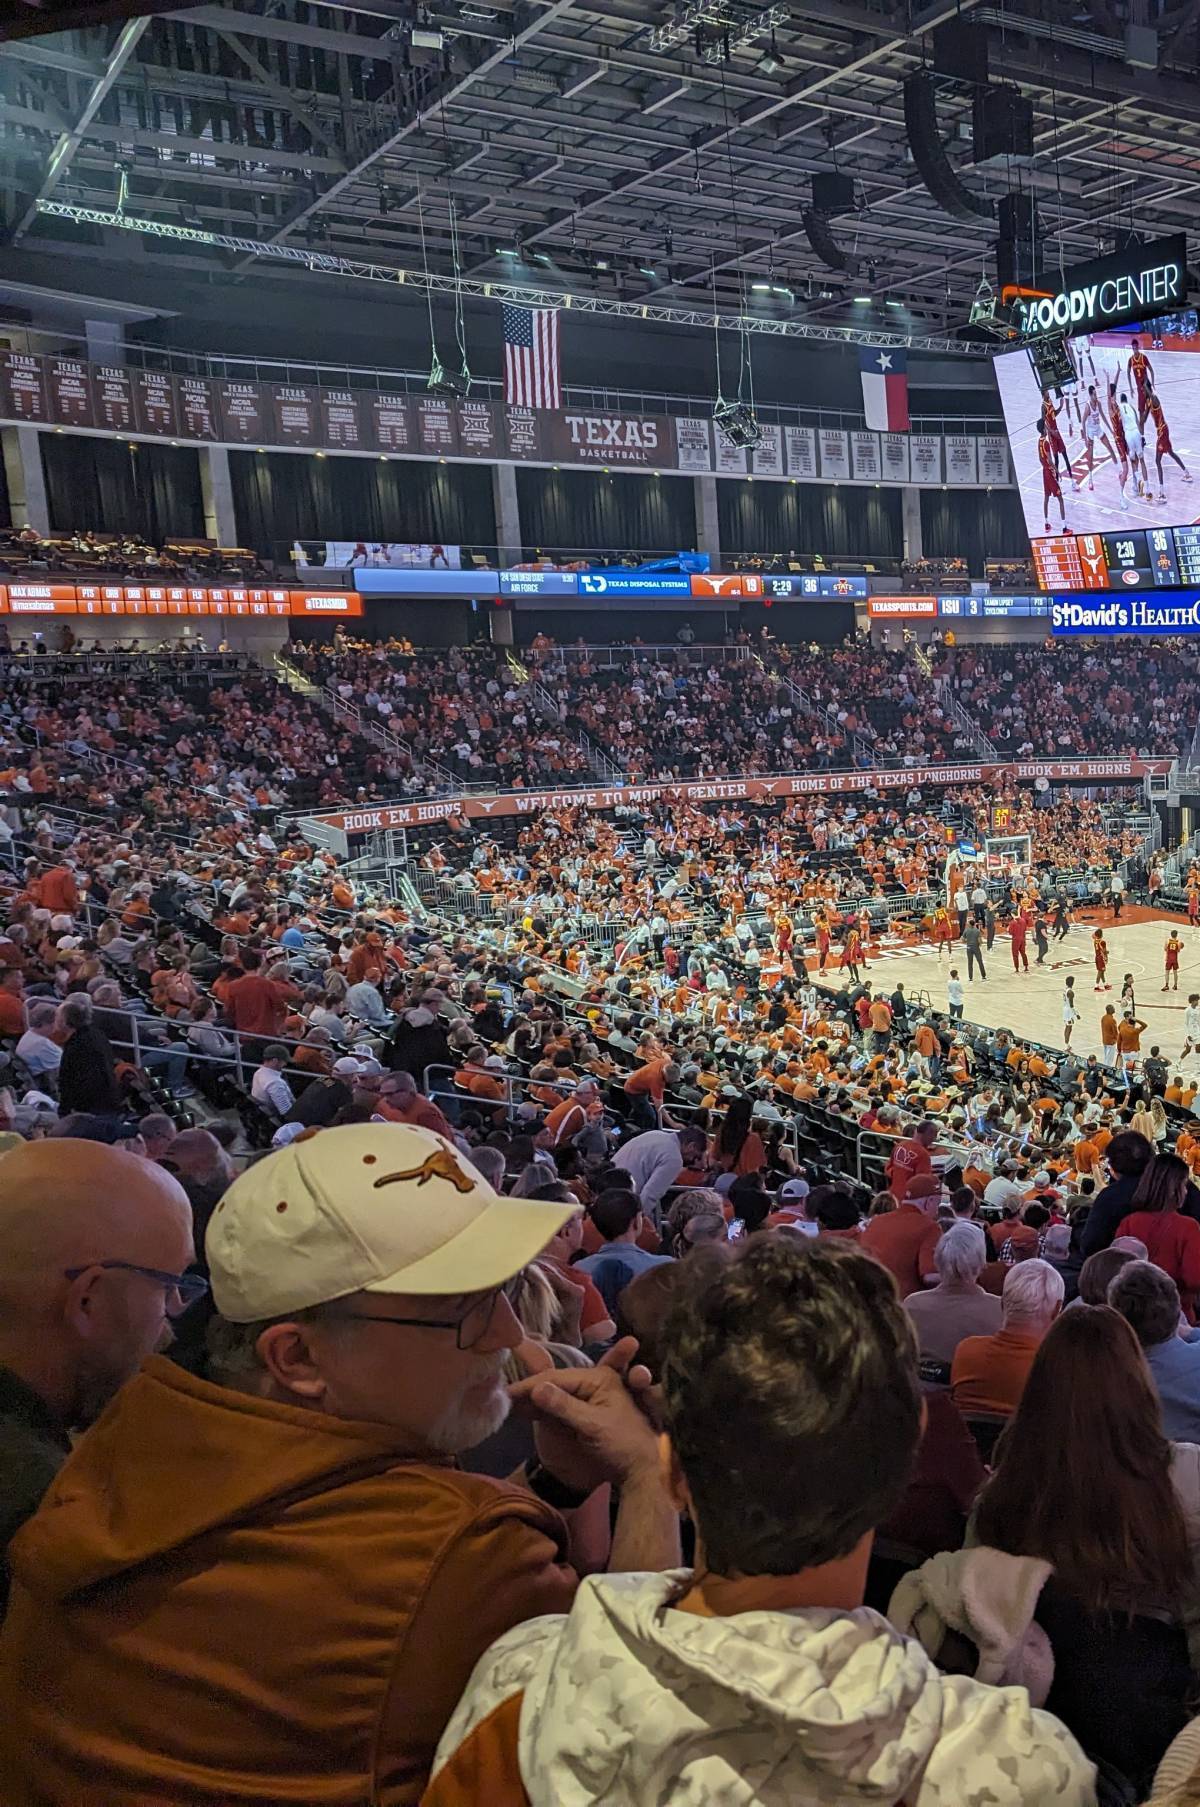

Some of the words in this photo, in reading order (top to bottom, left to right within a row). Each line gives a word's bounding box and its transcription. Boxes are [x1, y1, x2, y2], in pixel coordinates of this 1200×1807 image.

[1020, 284, 1098, 333] MOODY
[1099, 264, 1178, 314] CENTER
[57, 362, 82, 373] TEXAS
[101, 367, 124, 378] TEXAS
[144, 373, 166, 384] TEXAS
[228, 384, 254, 394] TEXAS
[280, 388, 306, 398] TEXAS
[327, 391, 353, 402] TEXAS
[464, 402, 486, 412] TEXAS
[511, 407, 532, 417] TEXAS
[682, 419, 702, 429] TEXAS
[565, 416, 659, 448] TEXAS
[580, 448, 648, 461] BASKETBALL
[1084, 536, 1096, 556] 19
[1152, 531, 1168, 551] 36
[1115, 542, 1135, 559] 2:30
[500, 573, 509, 582] 24
[511, 584, 521, 592] AIR
[521, 583, 539, 592] FORCE
[660, 581, 688, 589] SYSTEMS
[745, 578, 757, 593] 19
[773, 580, 792, 592] 2:29
[804, 579, 817, 592] 36
[833, 582, 854, 592] STATE
[11, 587, 25, 597] MAX
[82, 587, 95, 598] PTS
[871, 602, 934, 612] TEXASSPORTS.COM
[941, 599, 960, 614] ISU
[970, 600, 978, 614] 3
[1018, 764, 1054, 777] HOOK
[1087, 763, 1131, 775] HORNS
[791, 778, 828, 793] HOME
[829, 777, 844, 790] OF
[848, 776, 872, 789] THE
[876, 773, 914, 787] TEXAS
[917, 769, 982, 784] LONGHORNS
[514, 792, 596, 811] WELCOME
[602, 792, 626, 806] TO
[629, 787, 682, 801] MOOY
[687, 783, 747, 799] CENTER
[342, 814, 383, 830] HOOK
[417, 802, 461, 821] HORNS
[994, 815, 1008, 828] 30
